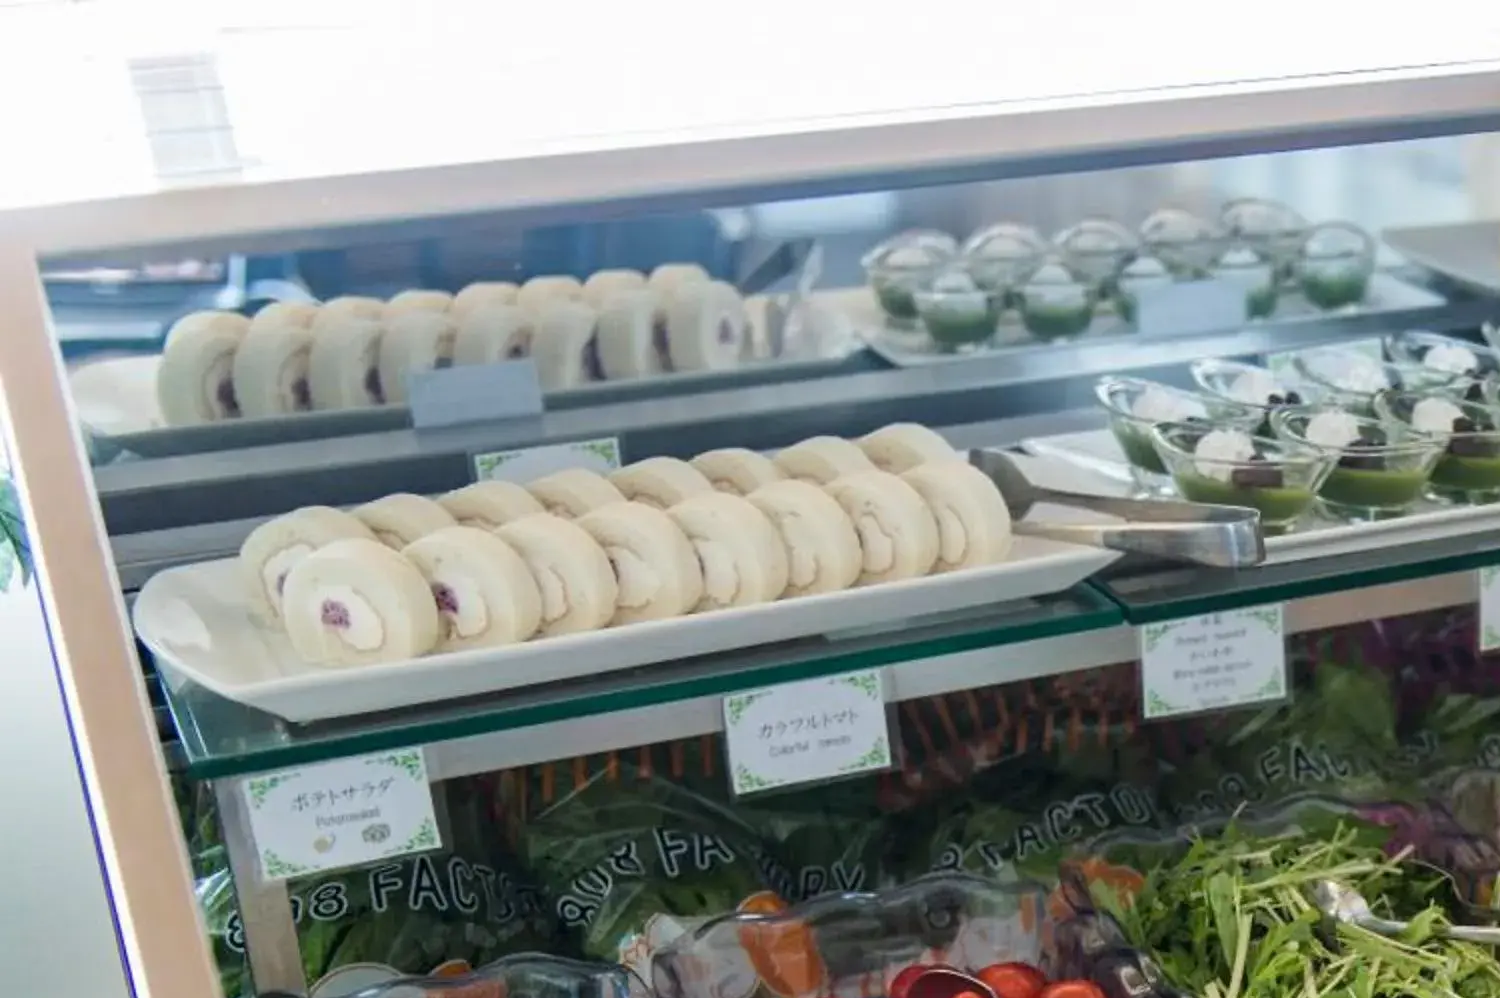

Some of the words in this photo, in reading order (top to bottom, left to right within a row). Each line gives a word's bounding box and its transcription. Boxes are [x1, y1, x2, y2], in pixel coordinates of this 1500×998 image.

[291, 776, 396, 811] ポテトサラダ
